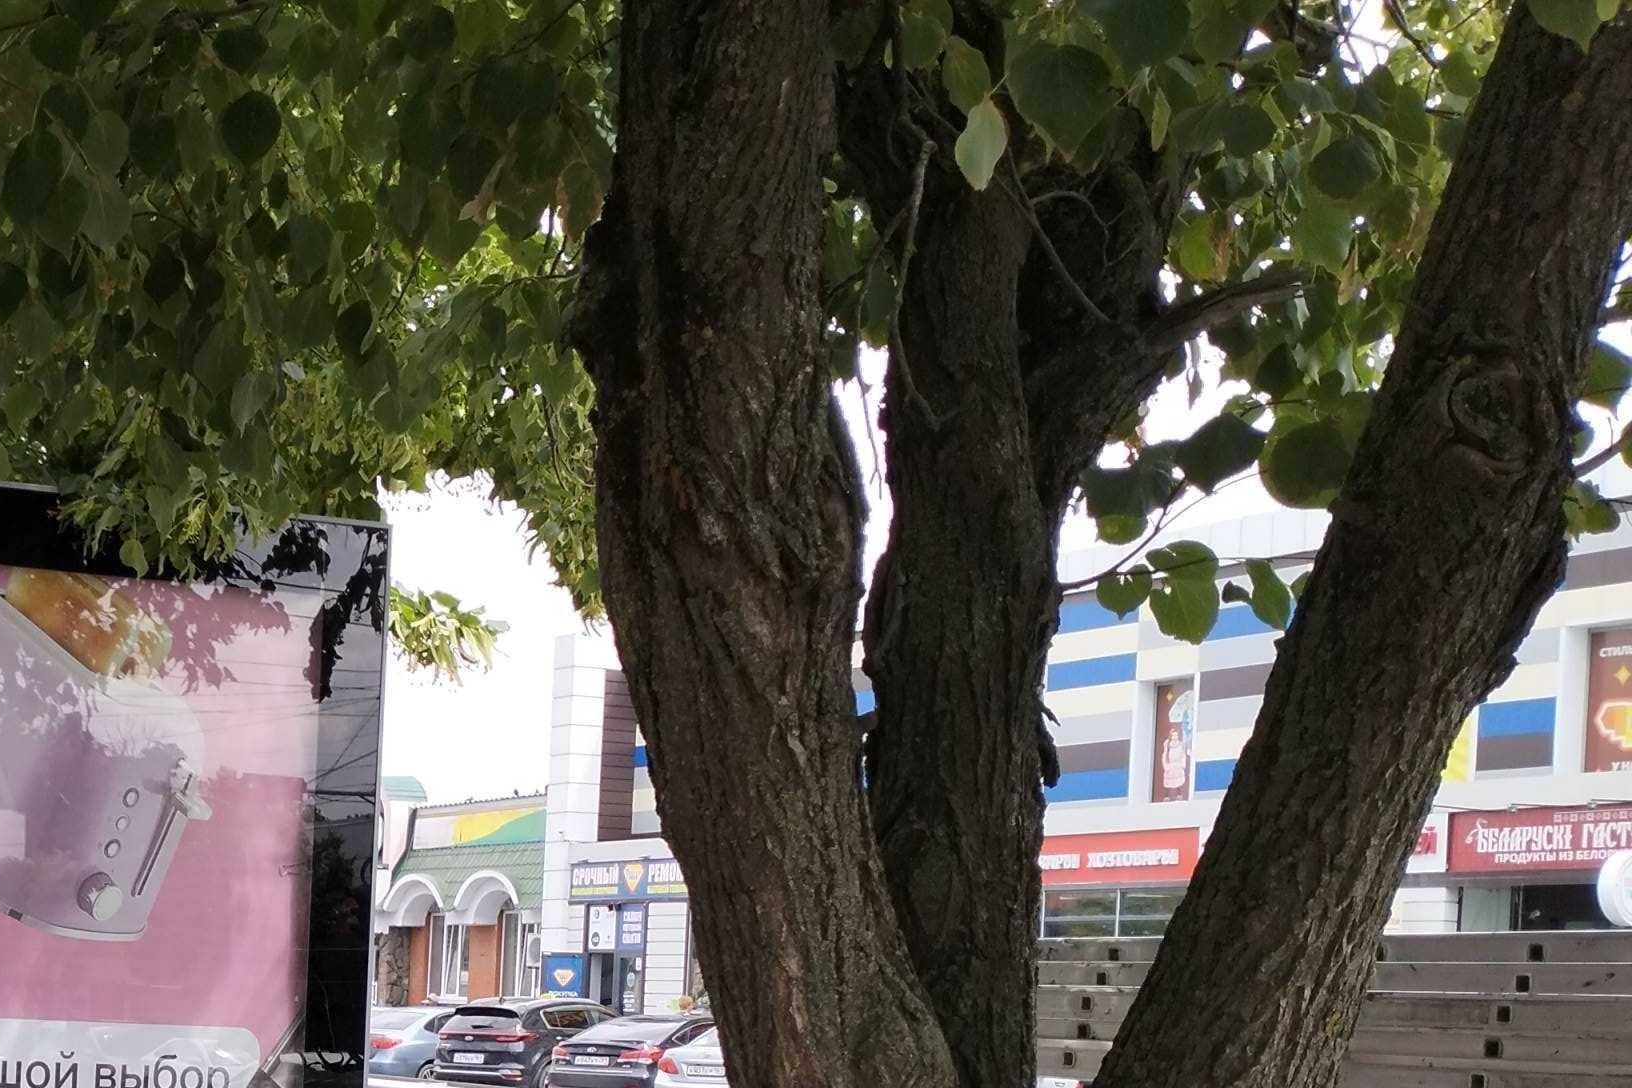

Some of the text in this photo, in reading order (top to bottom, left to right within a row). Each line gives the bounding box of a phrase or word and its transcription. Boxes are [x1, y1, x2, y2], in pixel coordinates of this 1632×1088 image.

[1581, 820, 1632, 849] ГАСТ
[1086, 849, 1179, 868] ХОЗТОВАРЫ
[1495, 851, 1557, 864] ПРОДУКТЫ
[1558, 850, 1574, 861] ИЗ
[573, 863, 619, 885] СРОЧНЫЙ
